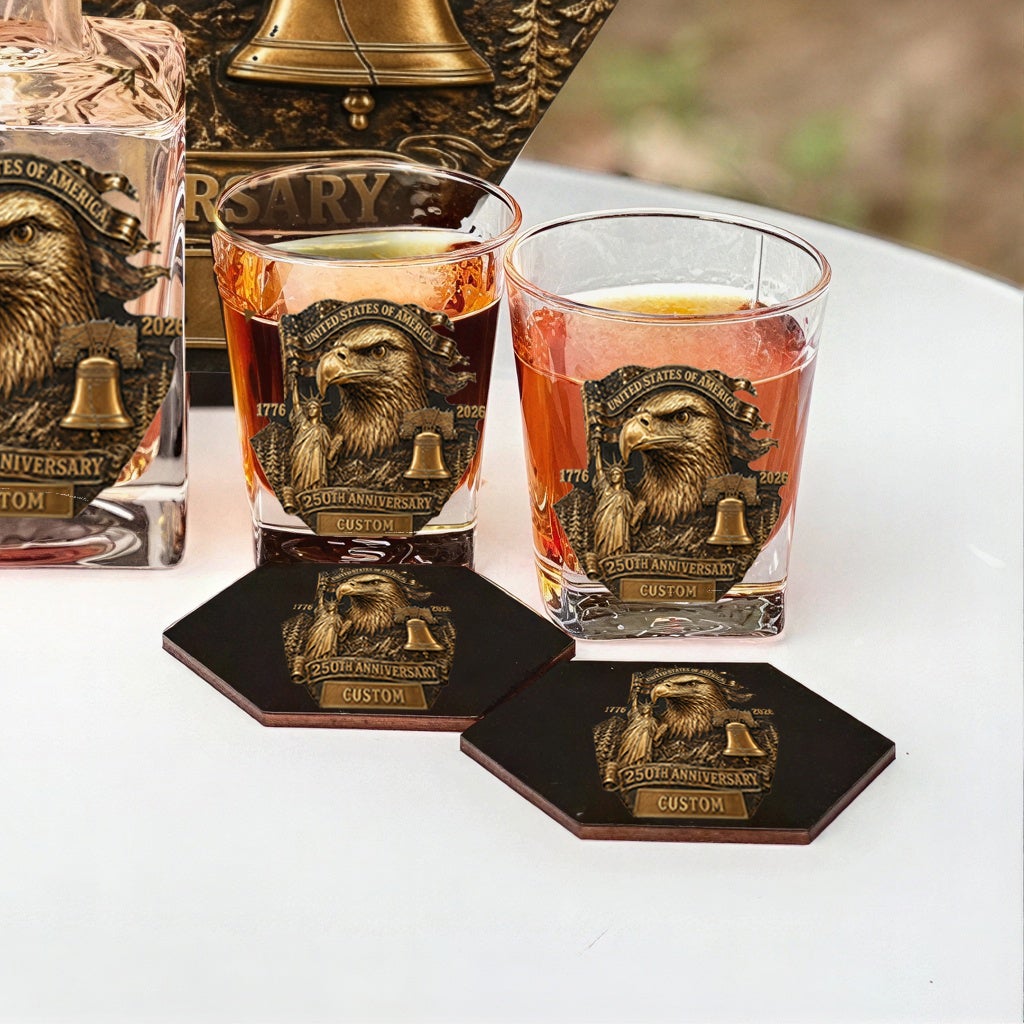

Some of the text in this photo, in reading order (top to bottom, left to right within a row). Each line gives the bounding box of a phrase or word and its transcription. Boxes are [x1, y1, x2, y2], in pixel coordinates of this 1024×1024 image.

[26, 160, 48, 179] OF
[45, 169, 108, 222] AMERICA
[304, 303, 436, 345] UNITED STATES OF AMERICA
[607, 369, 739, 412] UNITED STATES OF AMERICA
[256, 403, 286, 417] 1776
[456, 405, 486, 419] 2026
[559, 469, 589, 483] 1776
[759, 471, 788, 484] 2026
[302, 491, 432, 509] 250TH ANNIVERSARY
[336, 518, 394, 532] CUSTOM
[605, 557, 736, 575] 250TH ANNIVERSARY
[639, 584, 697, 598] CUSTOM
[312, 660, 437, 678] 250TH ANNIVERSARY
[343, 688, 406, 703] CUSTOM
[625, 768, 758, 786] 250TH ANNIVERSARY
[658, 795, 725, 812] CUSTOM
